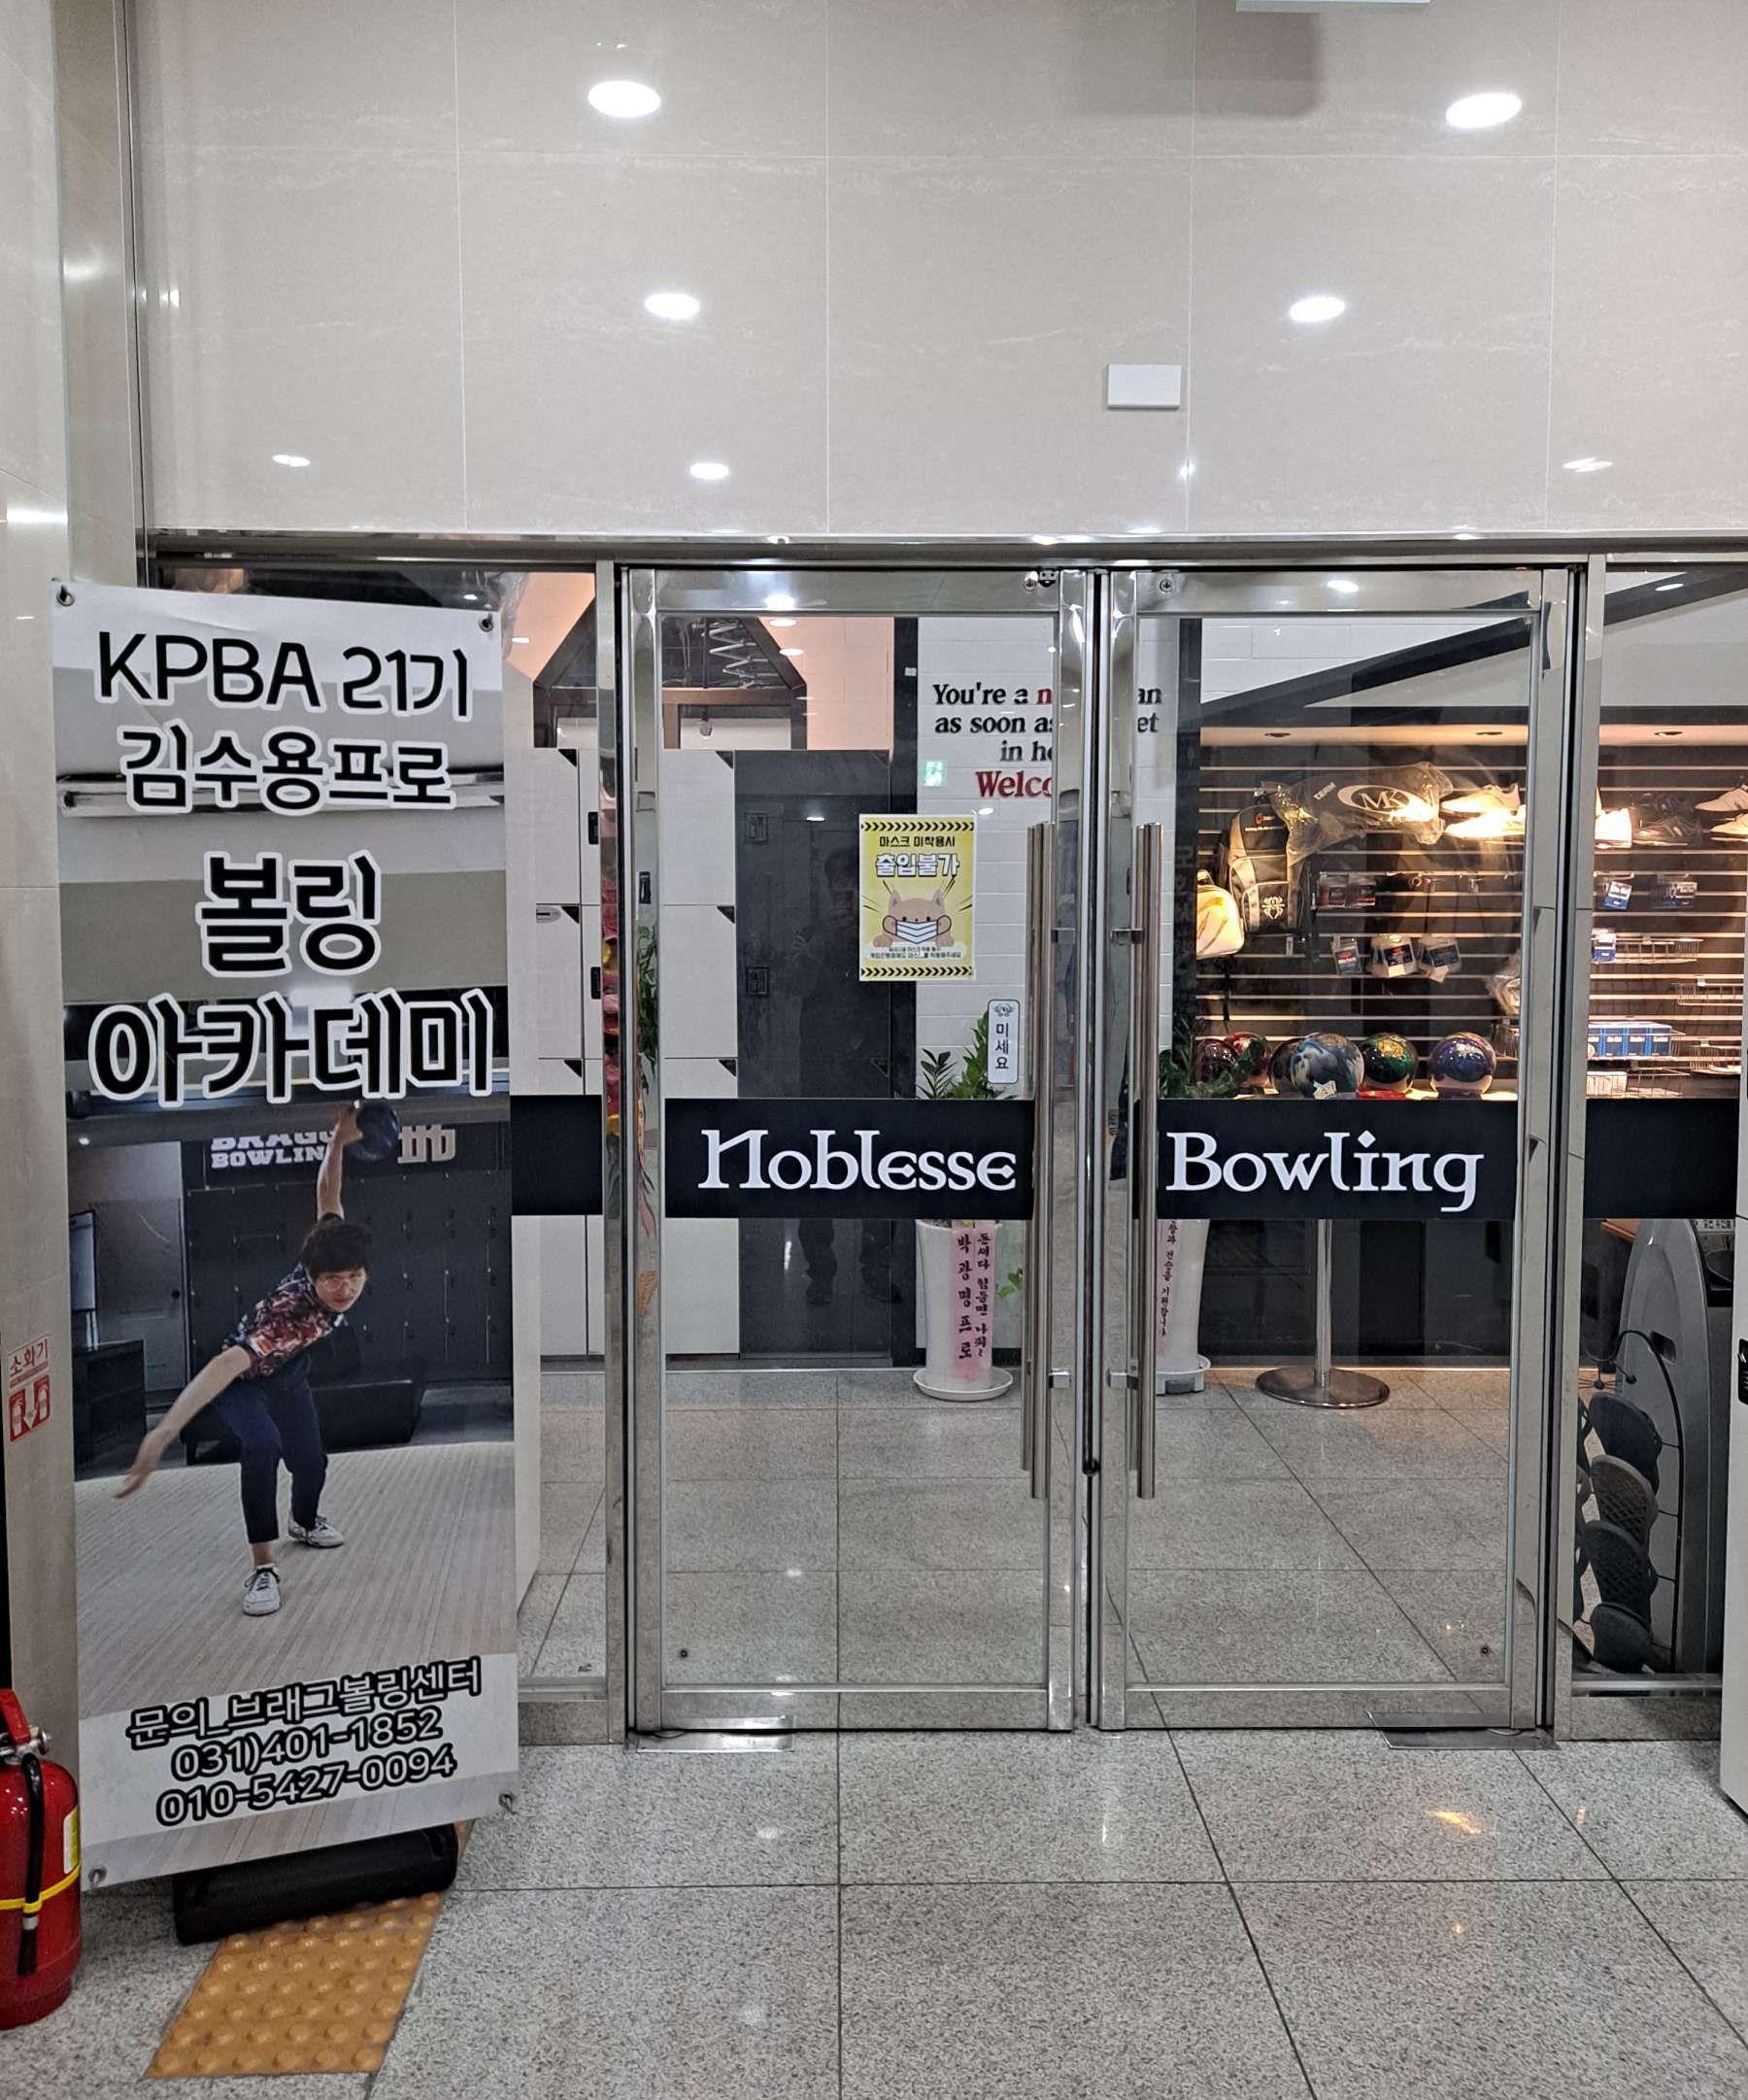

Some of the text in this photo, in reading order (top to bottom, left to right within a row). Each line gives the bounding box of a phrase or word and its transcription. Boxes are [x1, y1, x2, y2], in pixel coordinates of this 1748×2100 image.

[98, 630, 468, 717] KPBA 21기
[932, 682, 1006, 705] You're
[1014, 688, 1028, 704] a
[934, 717, 961, 733] as
[970, 717, 1025, 733] soon
[999, 739, 1023, 762] in
[121, 723, 452, 810] 김수용프로
[875, 853, 959, 877] 출입불가
[879, 836, 956, 848] 마스크 미착용시
[201, 855, 377, 971] 볼링
[93, 993, 489, 1102] 아카데미
[994, 1023, 1009, 1069] 미세요
[211, 1145, 328, 1169] BOWLIN
[697, 1129, 1017, 1192] Noblesse
[1165, 1130, 1485, 1212] Bowling
[10, 1338, 49, 1377] 소화기
[172, 1706, 443, 1781] 031)401-1852
[156, 1744, 456, 1826] 010-5427-0094
